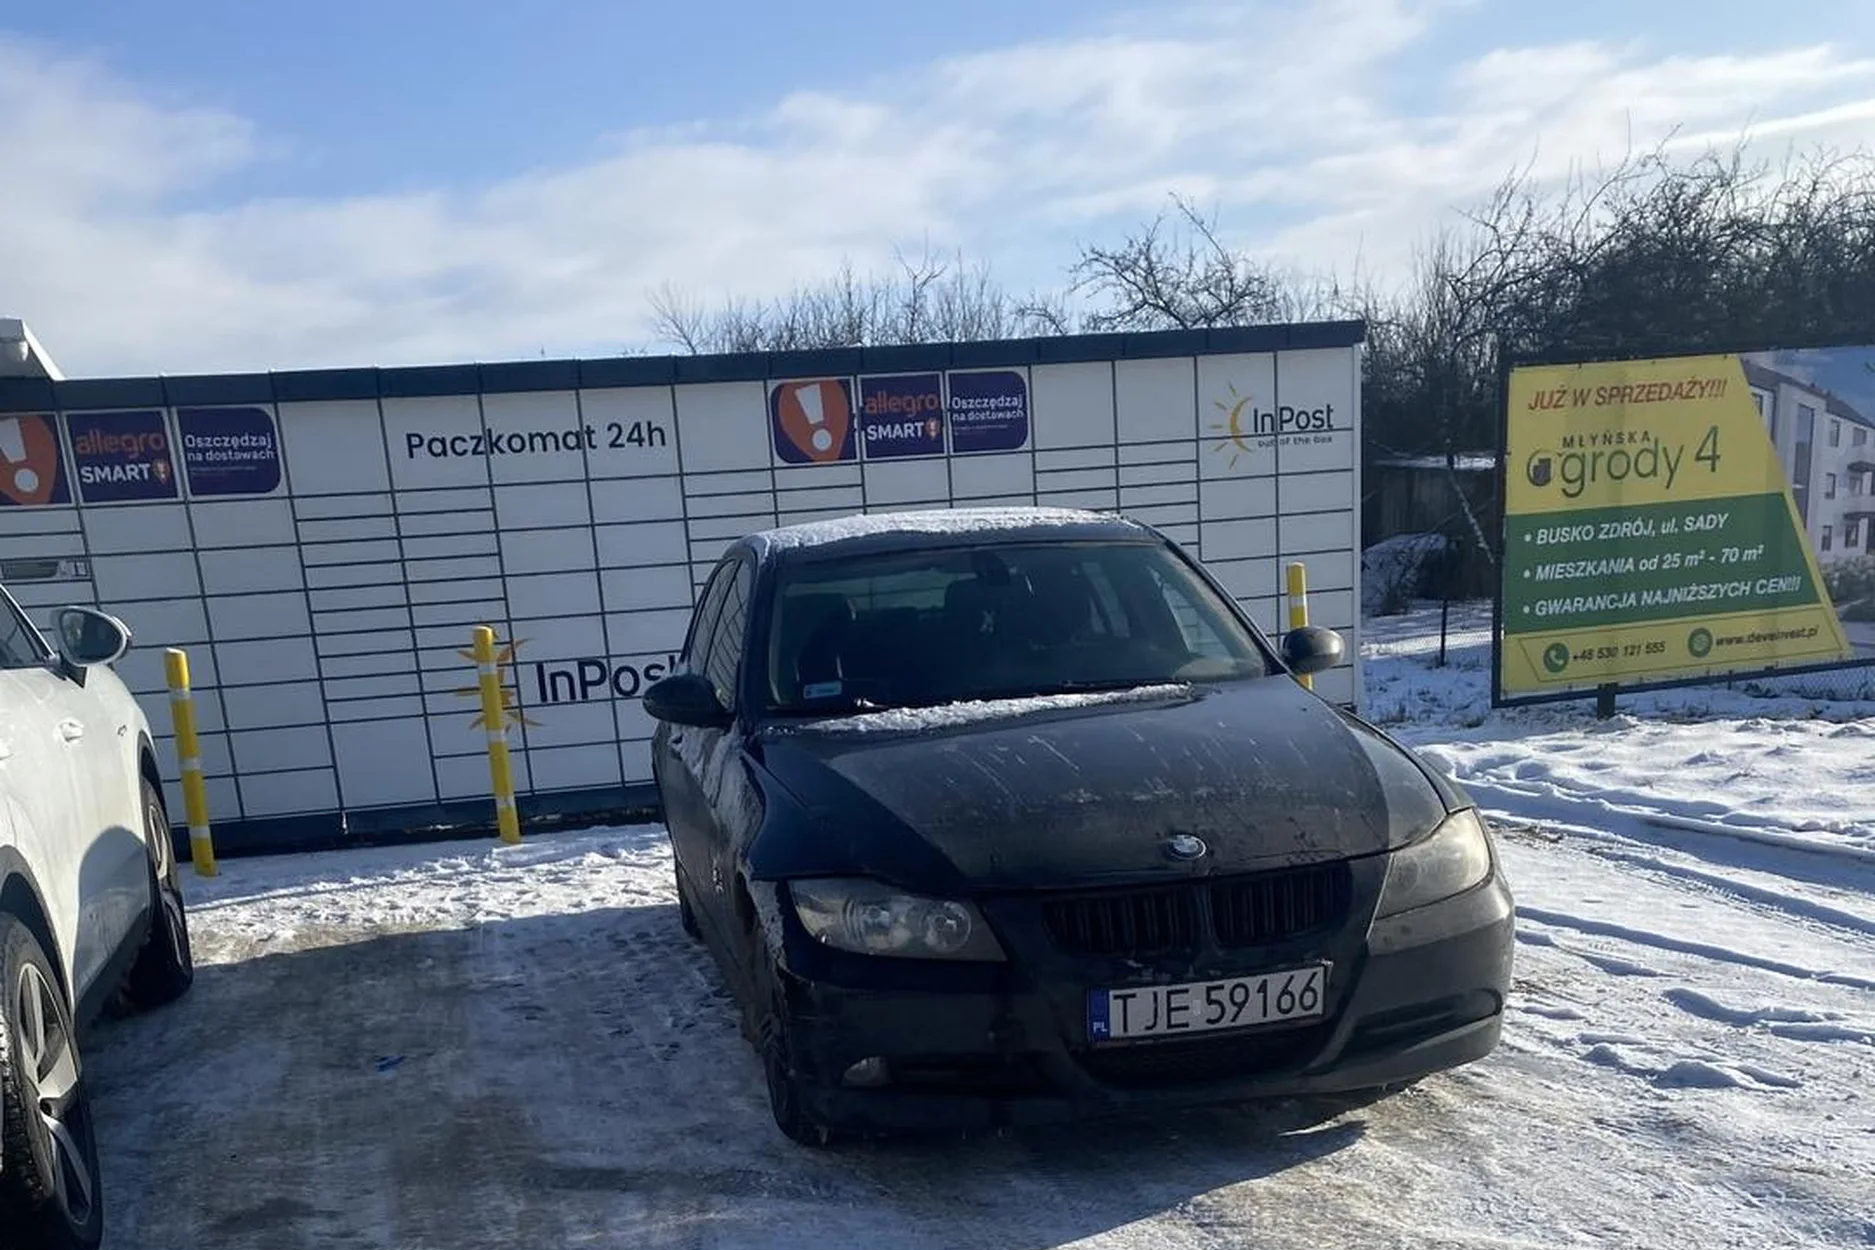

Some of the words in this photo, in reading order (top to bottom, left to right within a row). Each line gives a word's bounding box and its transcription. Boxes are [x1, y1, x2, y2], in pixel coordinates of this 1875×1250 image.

[865, 388, 939, 418] allegro
[951, 393, 1024, 410] Oszczędzaj
[1528, 383, 1567, 411] JUŻ
[1573, 388, 1592, 408] W
[1595, 376, 1728, 407] SPRZEDAŻY!!!
[952, 412, 966, 422] na
[967, 408, 1025, 422] dostawach
[1253, 403, 1334, 433] InPost
[76, 428, 165, 460] allegro
[184, 431, 272, 450] Oszczędzaj
[405, 424, 598, 459] Paczkomat
[606, 421, 667, 449] 24h
[866, 421, 925, 441] SMART
[1562, 430, 1651, 449] MŁYŃSKA
[187, 451, 203, 462] na
[205, 449, 276, 462] dostawach
[1694, 425, 1721, 473] 4
[80, 462, 151, 483] SMART
[1536, 525, 1595, 545] BUSKO
[1598, 516, 1656, 540] ZDRÓJ,
[1661, 517, 1679, 535] ul.
[1683, 513, 1730, 532] SADY
[1535, 557, 1635, 581] MIESZKANIA
[1639, 555, 1660, 571] od
[1662, 553, 1681, 569] 25
[1721, 546, 1740, 563] 70
[1535, 592, 1637, 616] GWARANCJA
[1641, 581, 1752, 607] NAJNIŻSZYCH
[1113, 988, 1190, 1034] TJE
[1206, 971, 1319, 1026] 59166
[1093, 1021, 1109, 1034] PL
